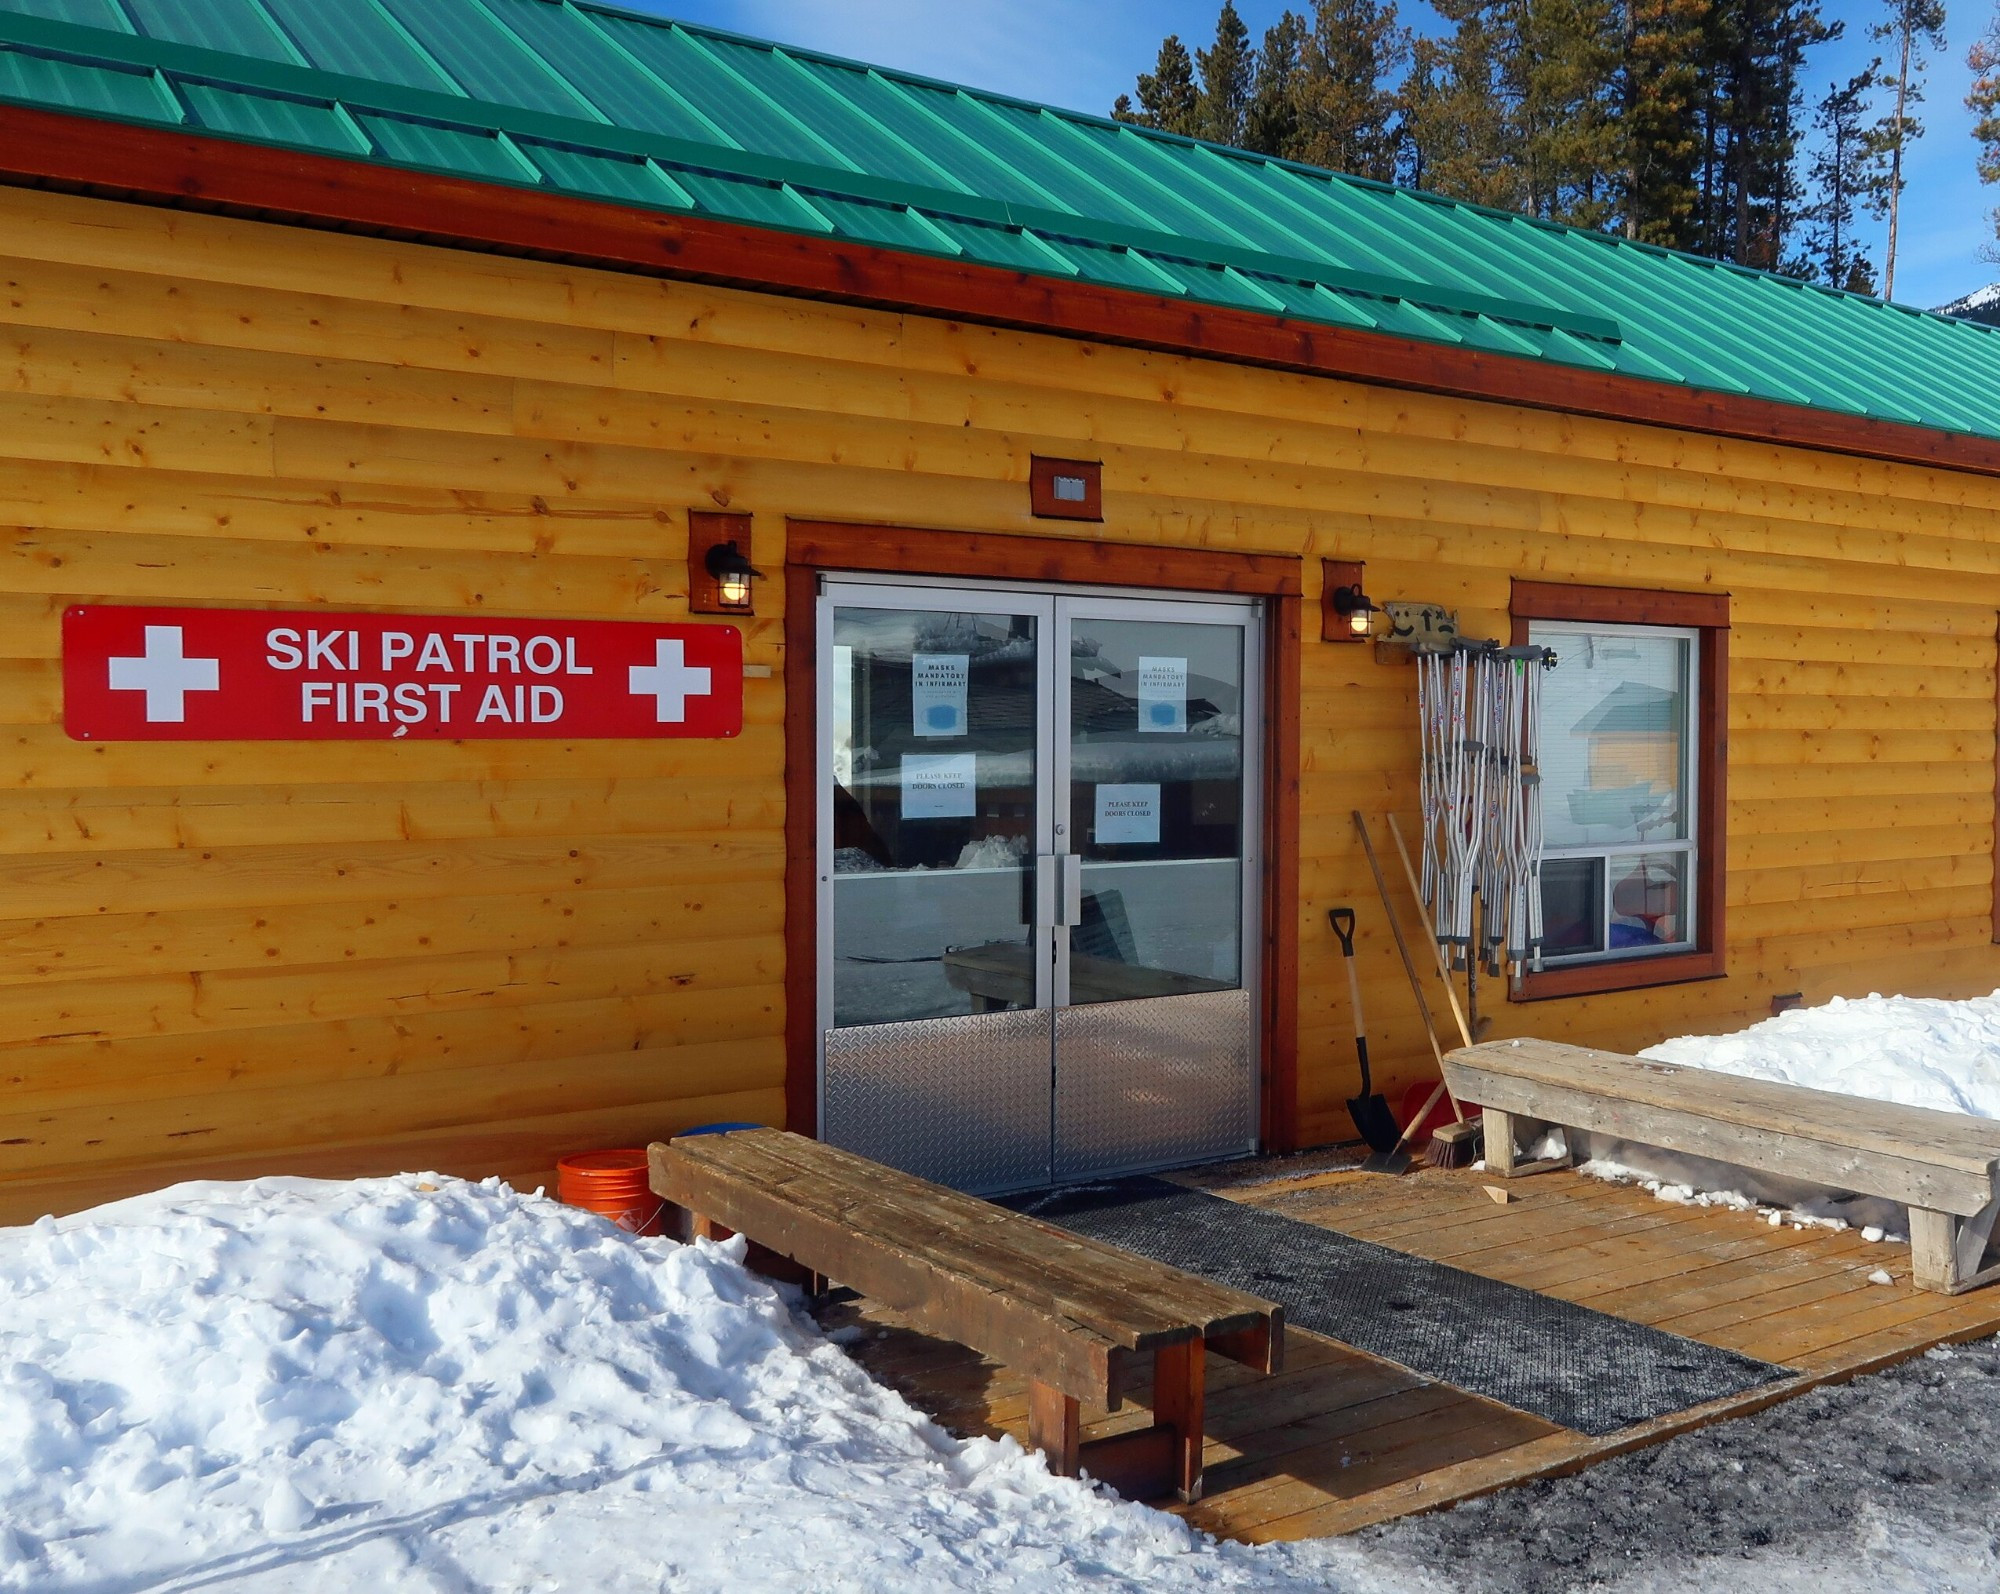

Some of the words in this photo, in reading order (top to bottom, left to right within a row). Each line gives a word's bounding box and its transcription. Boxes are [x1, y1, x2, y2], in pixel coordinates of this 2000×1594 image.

[266, 628, 359, 670] SKI
[381, 631, 593, 675] PATROL
[301, 682, 461, 723] FIRST
[475, 685, 564, 723] AID
